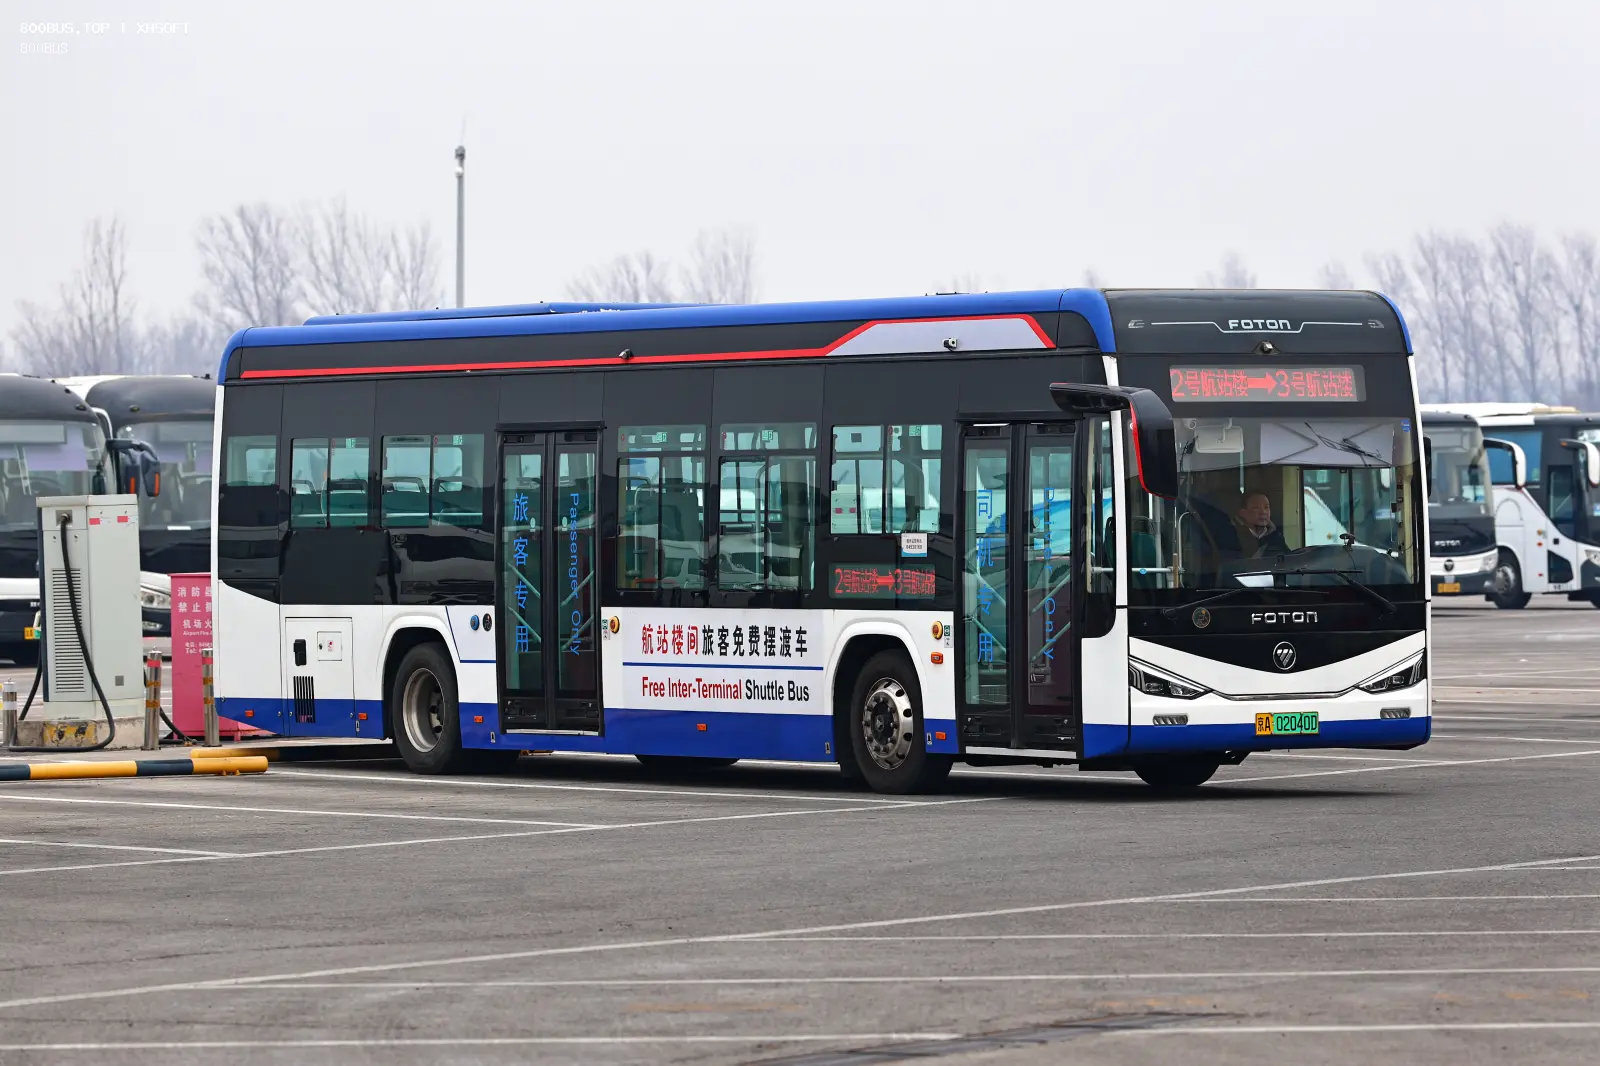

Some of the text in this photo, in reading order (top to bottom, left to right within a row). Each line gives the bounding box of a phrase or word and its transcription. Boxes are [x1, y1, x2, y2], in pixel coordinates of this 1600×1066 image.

[1228, 319, 1291, 330] FOTON
[1170, 369, 1356, 398] 2号航站楼 3号航站楼
[513, 492, 529, 652] 旅客专用
[568, 493, 582, 655] Passenger Only
[976, 489, 994, 662] 司机专用
[1043, 487, 1056, 659] Driver Only
[1251, 611, 1318, 624] FOTON
[641, 623, 808, 658] 航站楼间旅客免费摆渡车
[642, 676, 810, 702] Free Inter-Terminal Shuttle Bus
